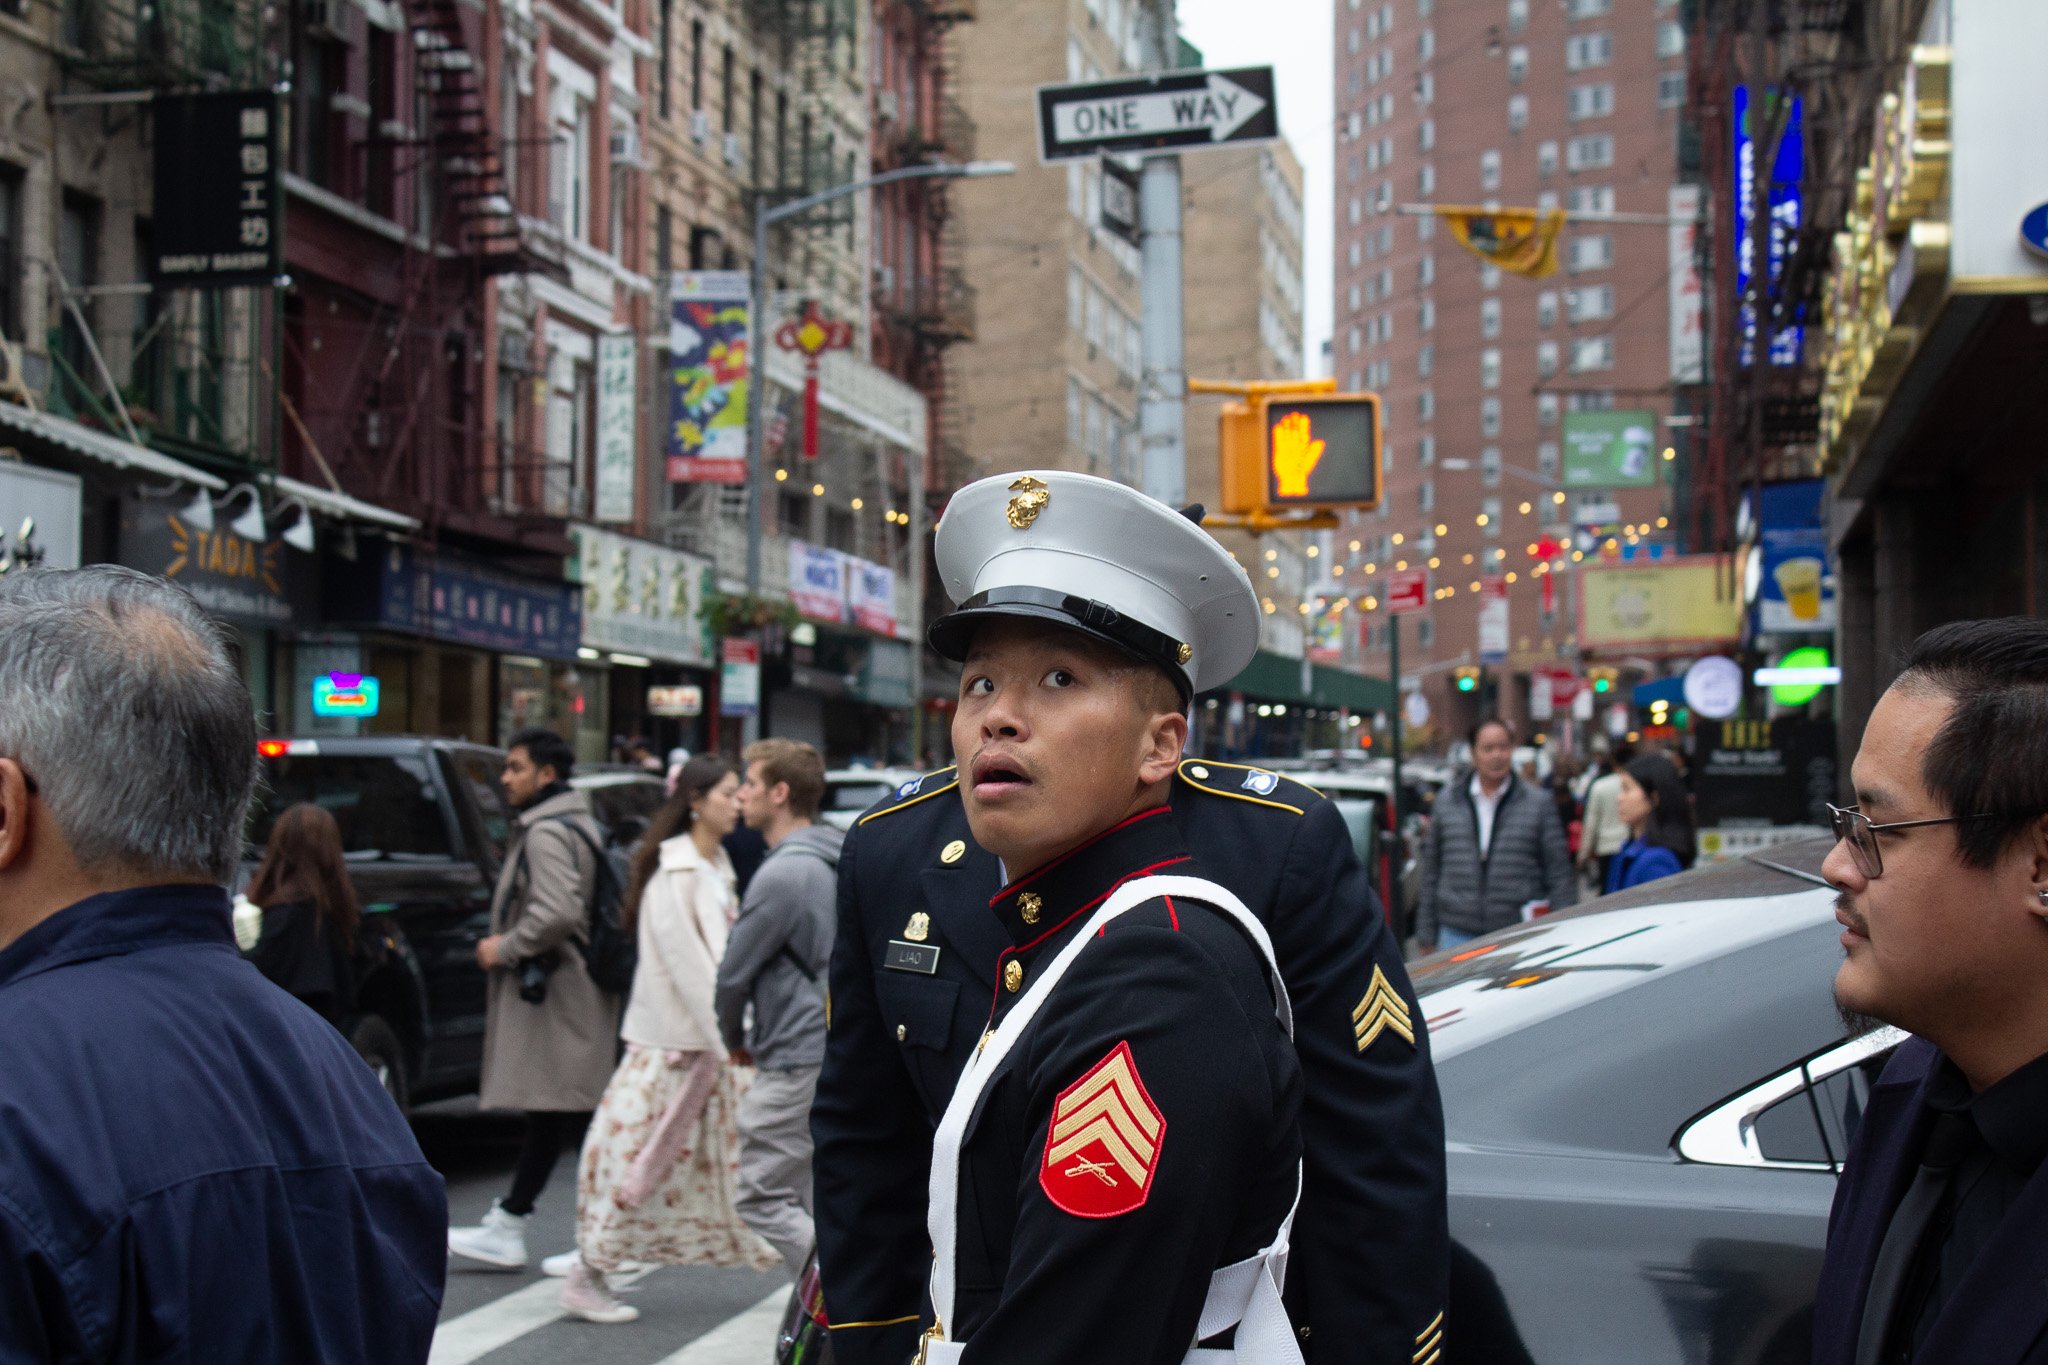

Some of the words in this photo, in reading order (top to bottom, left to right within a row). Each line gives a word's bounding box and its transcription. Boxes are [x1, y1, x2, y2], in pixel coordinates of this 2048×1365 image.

[1073, 101, 1141, 135] ONE
[1171, 91, 1240, 124] WAY
[195, 528, 257, 580] TADA
[899, 949, 922, 965] LIAO
